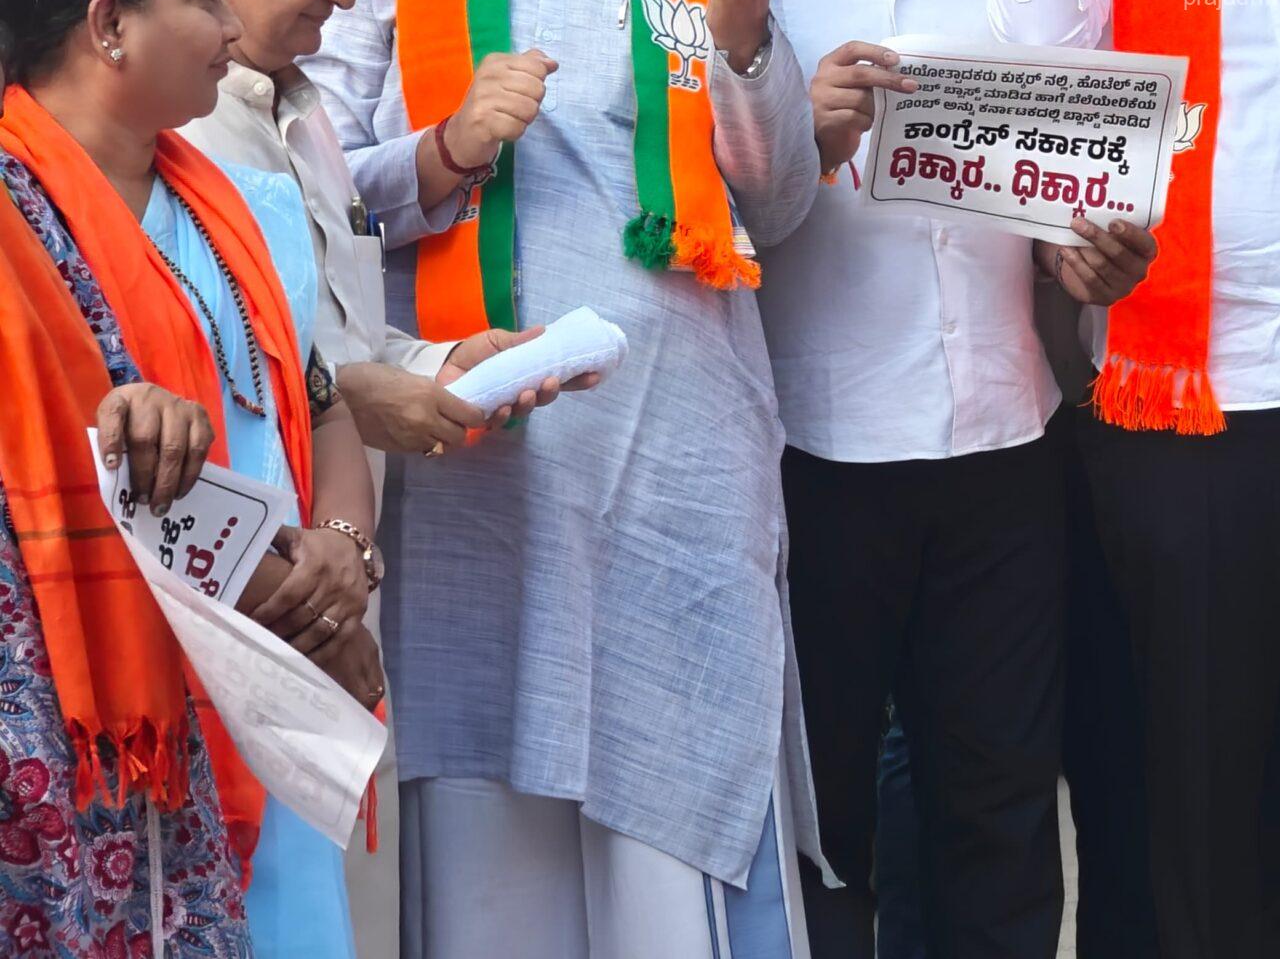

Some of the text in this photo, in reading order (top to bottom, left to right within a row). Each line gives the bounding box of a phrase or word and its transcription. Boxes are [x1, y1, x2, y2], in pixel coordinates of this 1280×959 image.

[984, 89, 1031, 100] ಮಾಡಿದ
[1035, 92, 1065, 103] ಹಾಗೆ
[1001, 71, 1041, 88] ಕುಕ್ಕರ್
[1134, 80, 1157, 96] ನಲ್ಲಿ
[896, 98, 940, 111] ಬಾಂಬ್
[944, 99, 975, 116] ಅನ್ನು
[979, 104, 1060, 123] ಕರ್ನಾಟಕದಲ್ಲಿ
[1103, 114, 1150, 128] ಮಾಡಿದ
[904, 120, 1130, 175] ಕಾಂಗ್ರೆಸ್ ಸರ್ಕಾರಕ್ಕೆ
[889, 146, 1135, 218] ಧಿಕ್ಕಾರ.. ಧಿಕ್ಕಾರ...
